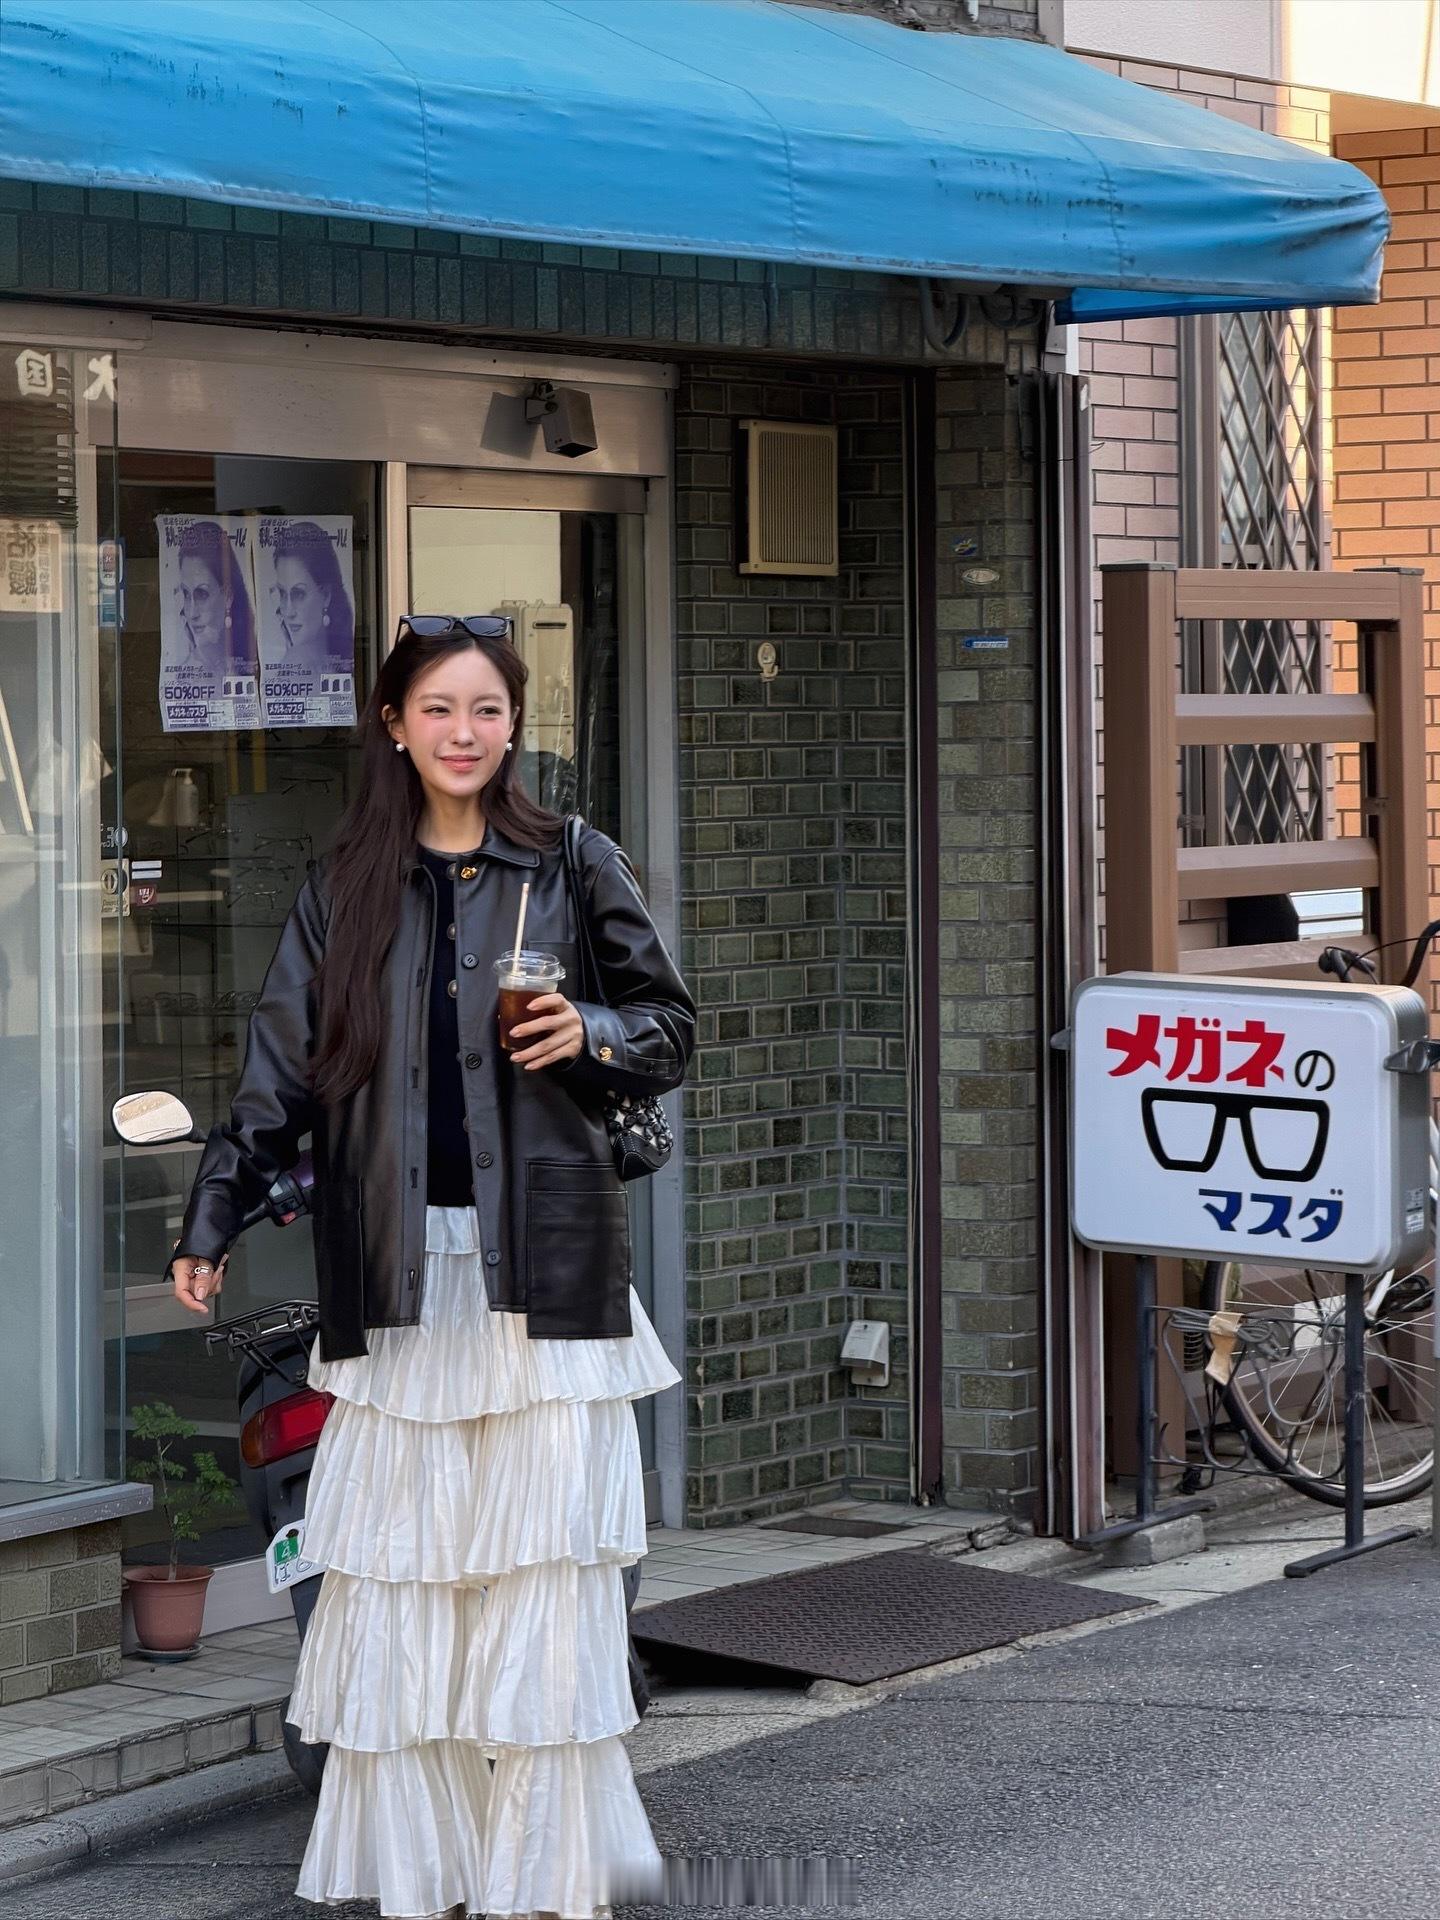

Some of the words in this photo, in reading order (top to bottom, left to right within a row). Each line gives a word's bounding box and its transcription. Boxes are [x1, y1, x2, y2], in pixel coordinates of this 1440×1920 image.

[164, 685, 215, 699] 50%OFF
[264, 683, 313, 697] 50%OFF
[1105, 1014, 1336, 1092] メガネの
[1198, 1188, 1344, 1243] マスダ
